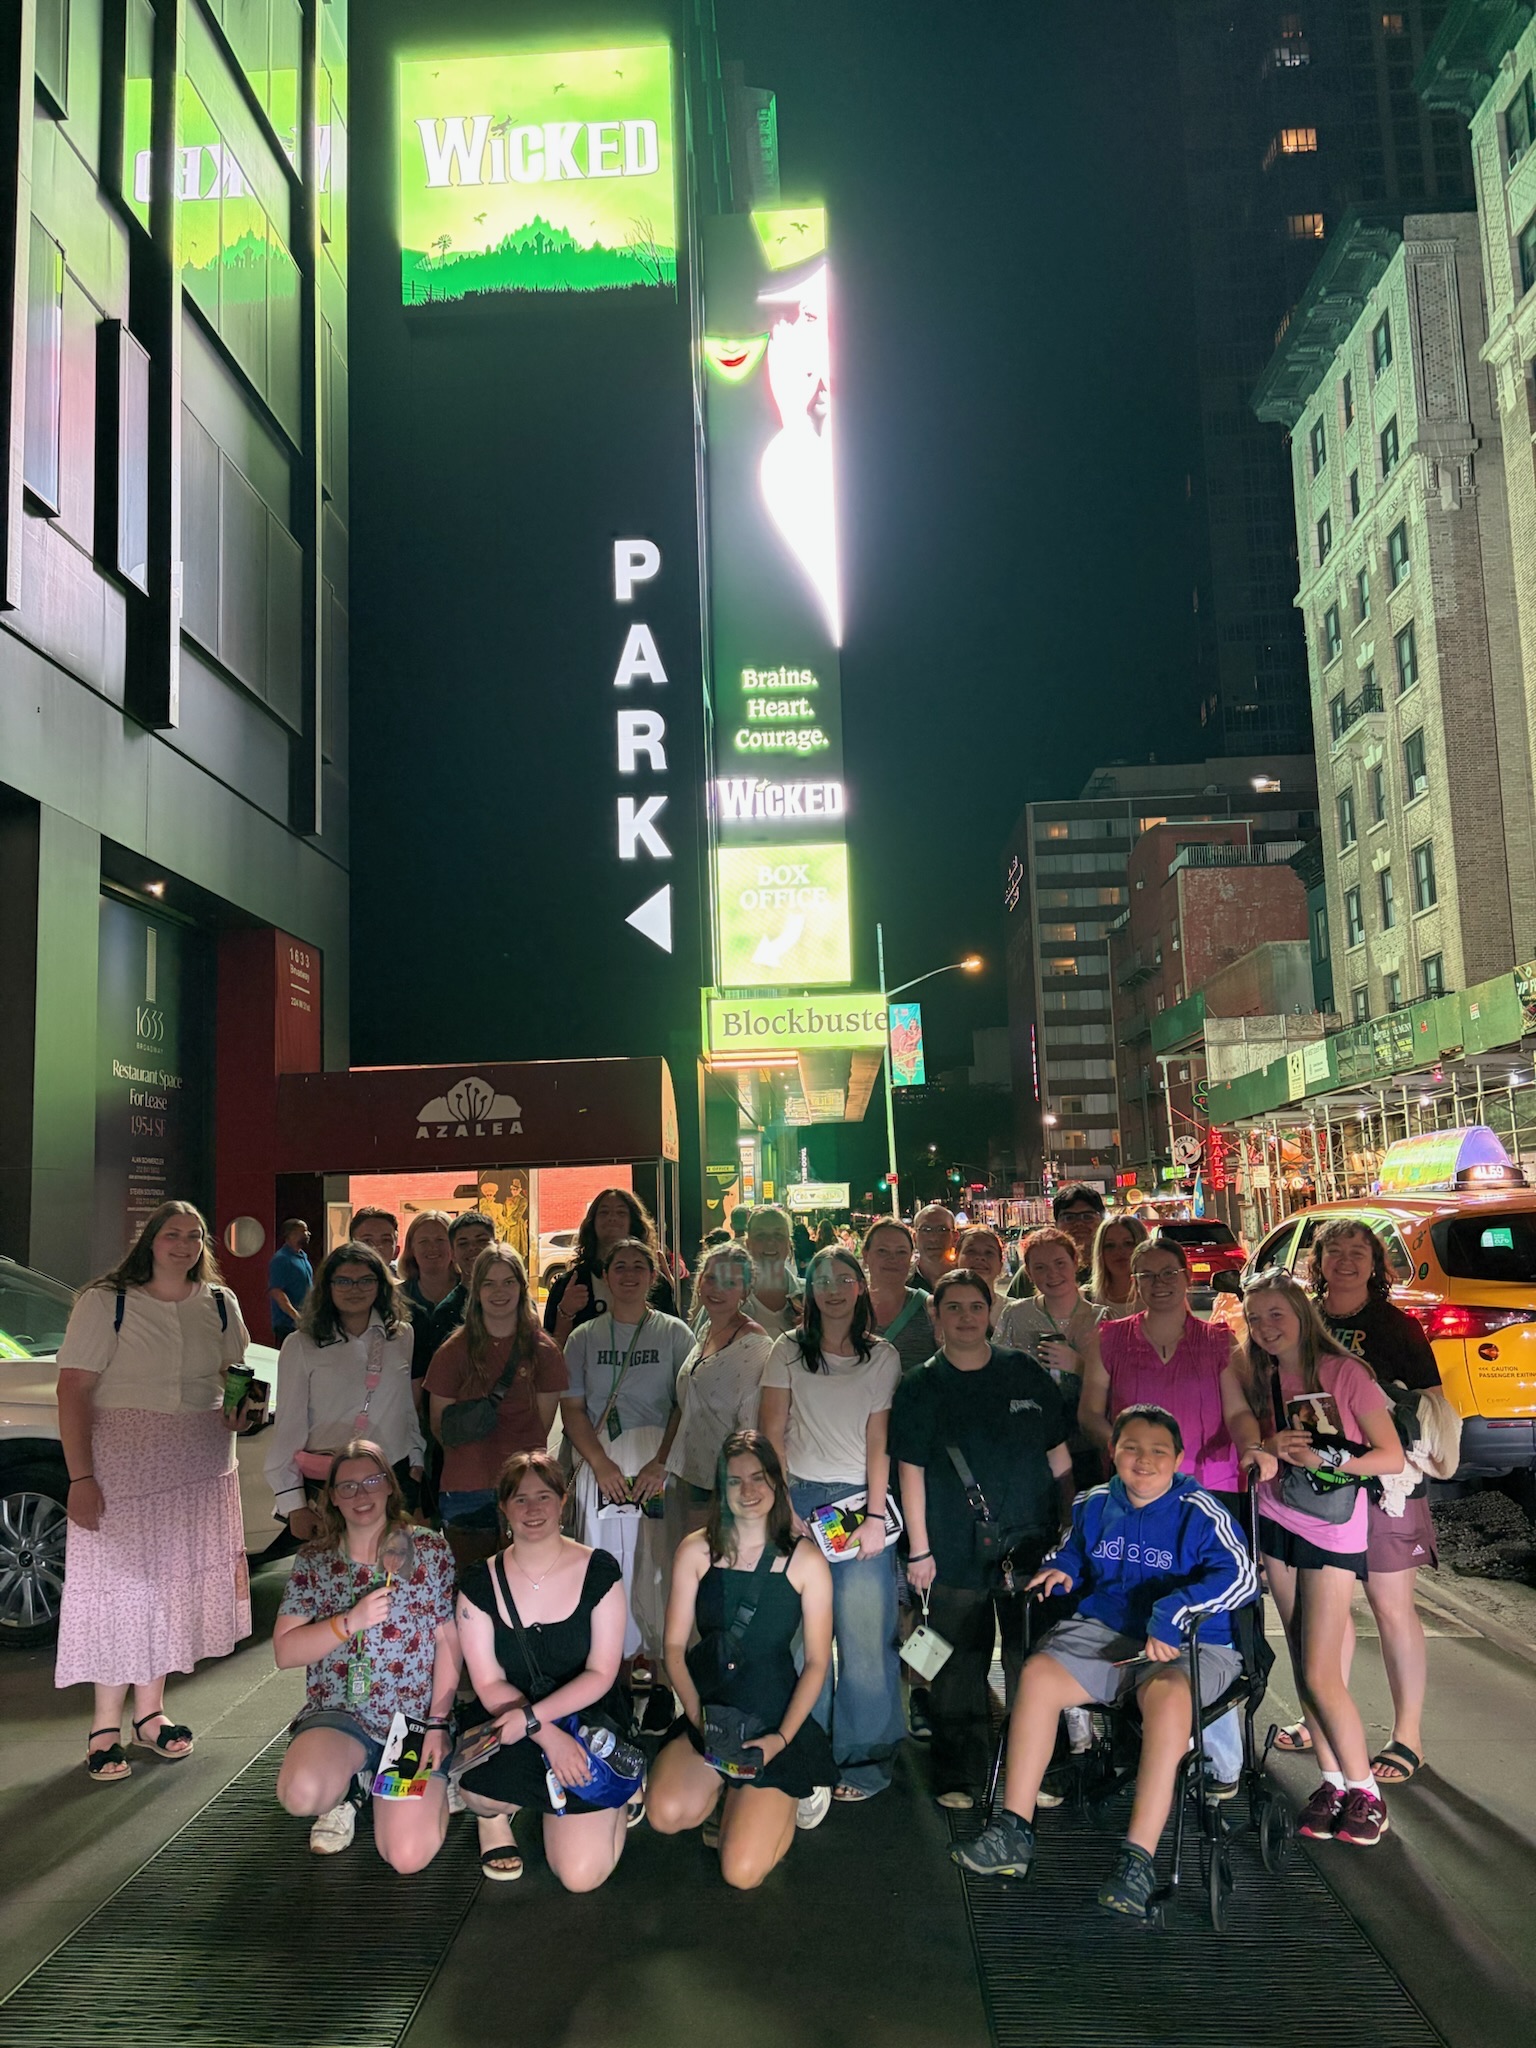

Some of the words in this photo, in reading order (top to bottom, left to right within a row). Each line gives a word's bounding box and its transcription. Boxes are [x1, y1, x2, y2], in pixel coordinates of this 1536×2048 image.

[742, 665, 818, 689] Brains.
[614, 539, 672, 859] PARK
[747, 697, 815, 718] Heart.
[735, 728, 829, 751] Courage.
[755, 864, 810, 886] BOX
[739, 887, 829, 911] OFFICE
[289, 947, 310, 969] 1633
[136, 1006, 164, 1042] 1633
[722, 1007, 888, 1037] Blockbuste
[112, 1059, 159, 1085] Restaurant
[159, 1069, 183, 1091] Space
[129, 1088, 144, 1107] For
[144, 1091, 168, 1111] Lease
[416, 1121, 523, 1139] AZALEA
[1092, 1536, 1173, 1570] addas
[376, 1781, 424, 1793] PLAYBILL
